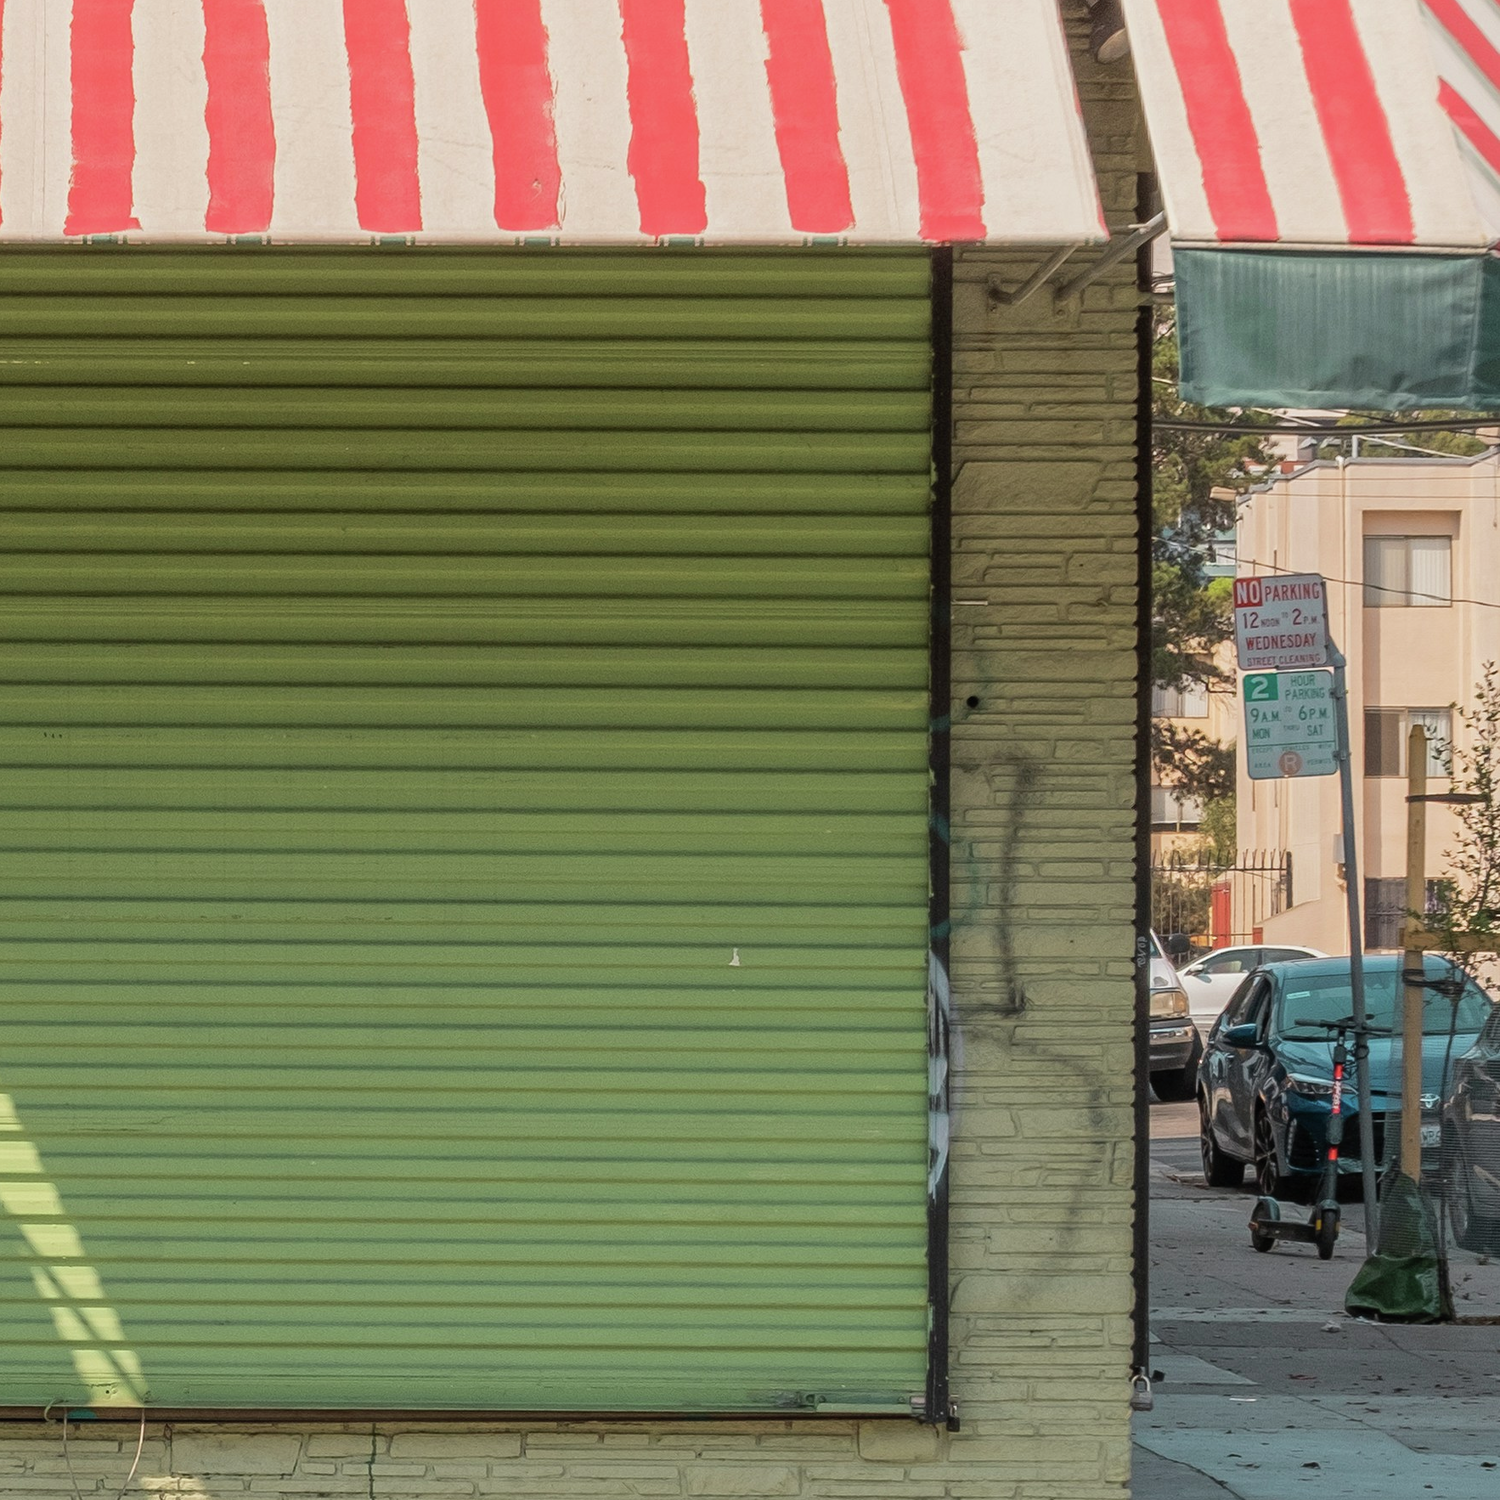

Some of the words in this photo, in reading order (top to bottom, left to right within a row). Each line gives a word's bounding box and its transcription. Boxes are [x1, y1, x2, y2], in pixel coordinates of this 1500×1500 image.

[1236, 580, 1260, 604] NO
[1264, 582, 1320, 602] PARKING
[1243, 611, 1259, 629] 12
[1291, 608, 1302, 625] 2
[1245, 632, 1317, 651] WEDNESDAY
[1247, 656, 1277, 667] STREET
[1278, 653, 1321, 664] CLEANING
[1250, 676, 1270, 699] 2
[1290, 674, 1316, 686] HOUR
[1284, 687, 1325, 700] PARKING
[1252, 728, 1271, 739] MON
[1306, 724, 1324, 736] SAT
[1284, 754, 1298, 771] R
